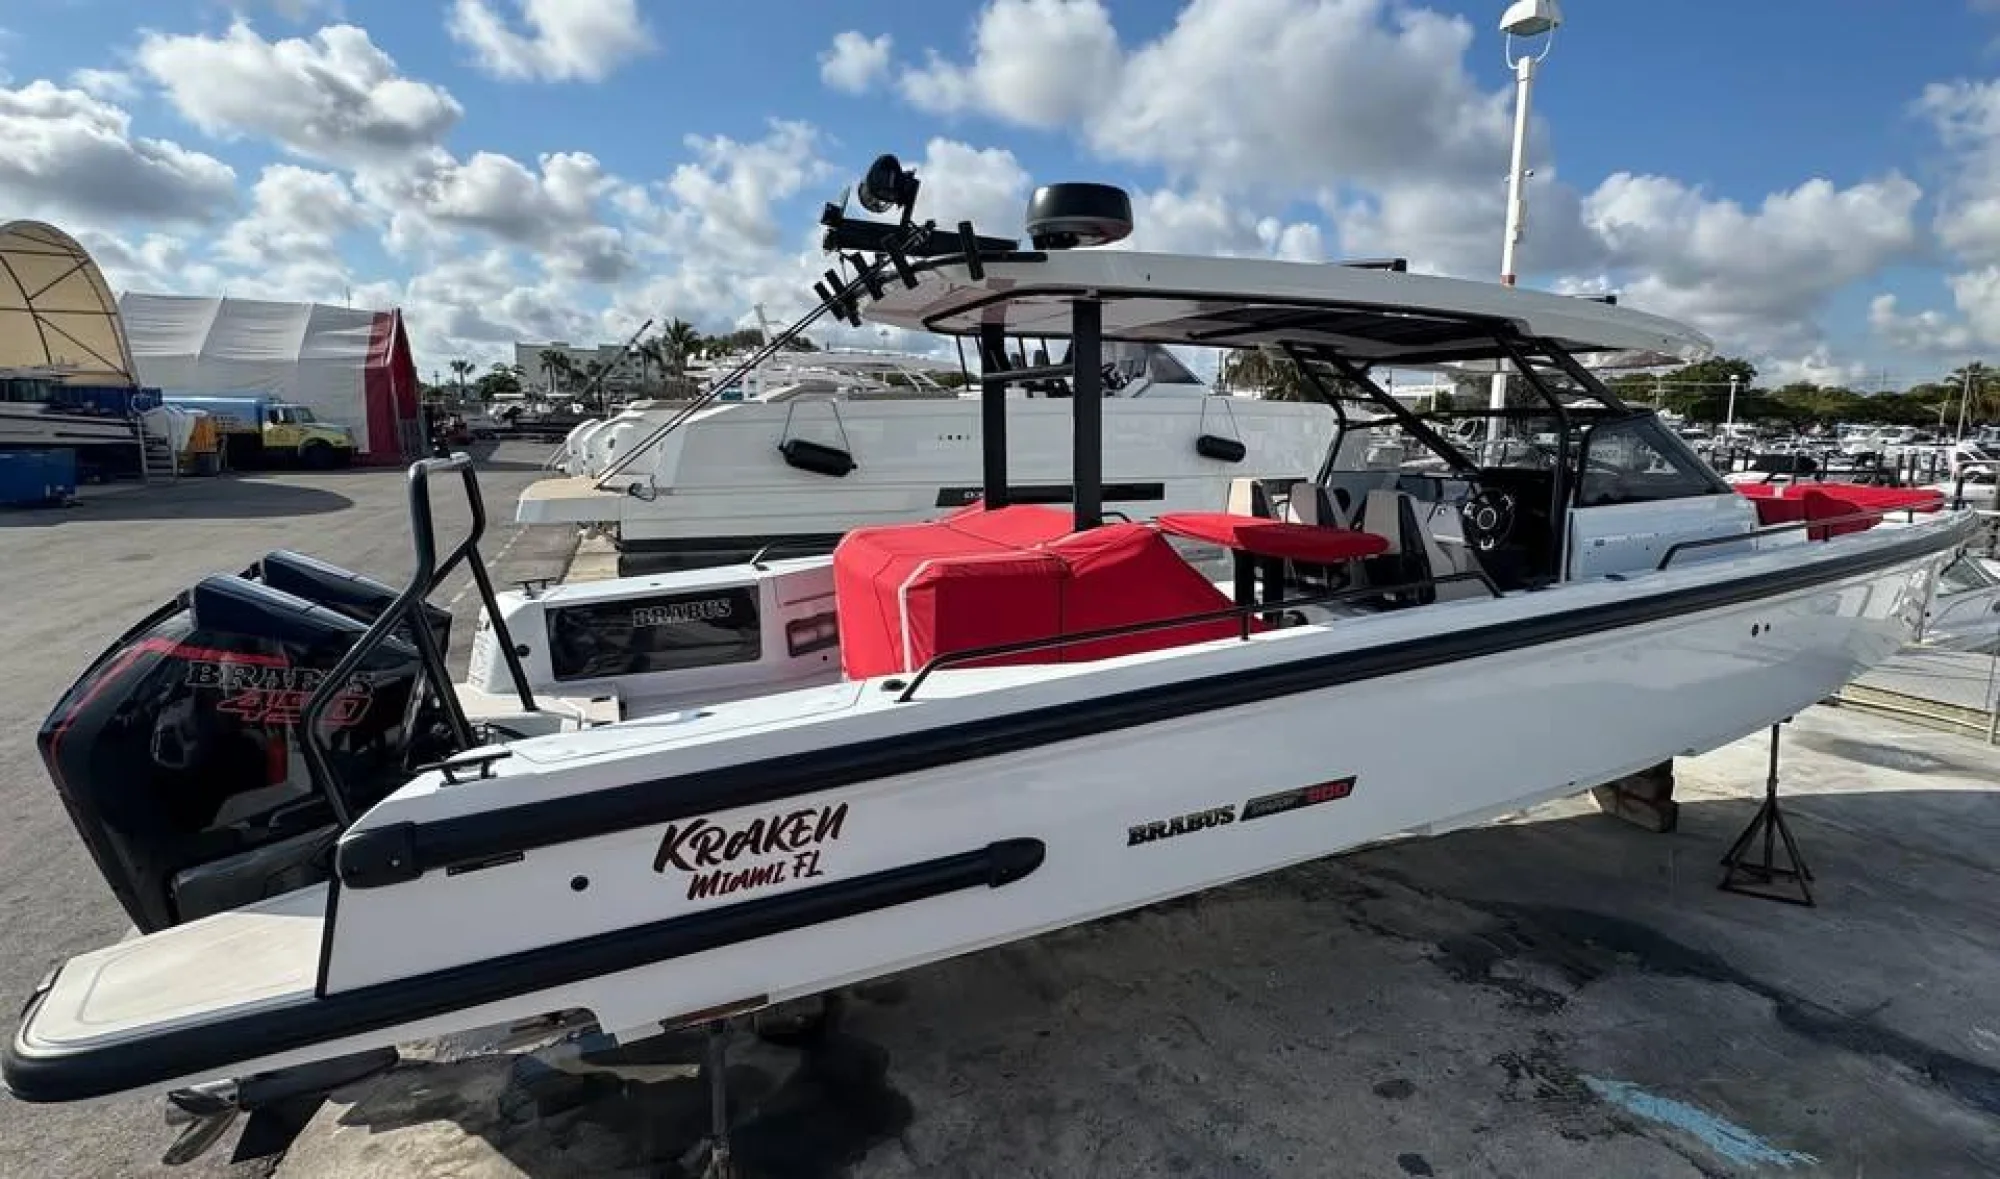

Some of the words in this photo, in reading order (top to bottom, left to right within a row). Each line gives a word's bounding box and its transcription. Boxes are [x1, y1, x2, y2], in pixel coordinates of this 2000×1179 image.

[632, 598, 732, 628] BRABUS
[185, 660, 375, 692] BRABS
[653, 802, 849, 873] KRAKEN
[1127, 803, 1235, 847] BRABUS
[687, 860, 786, 900] MIAMI
[793, 850, 824, 878] FL
